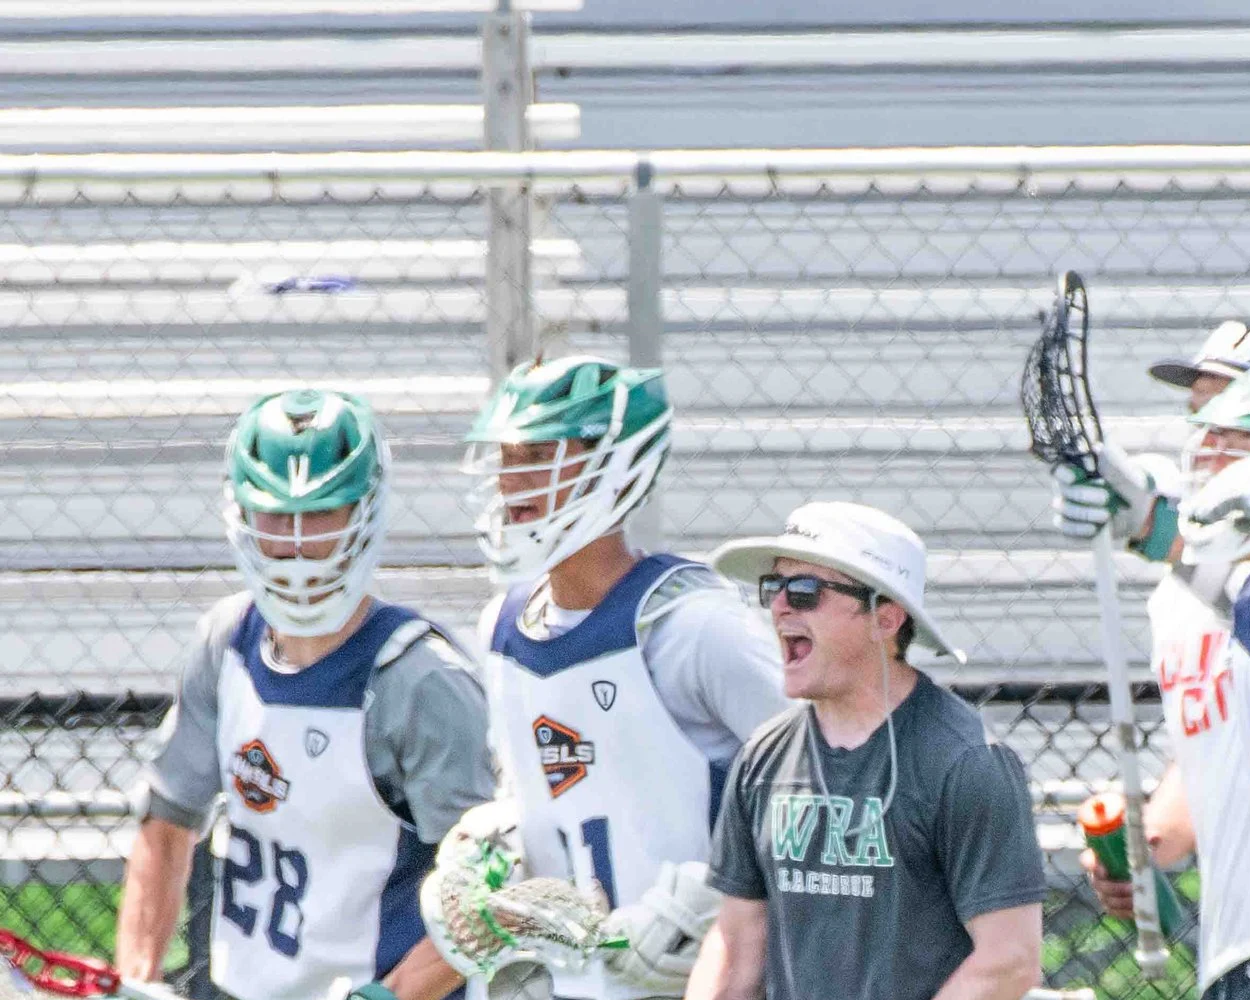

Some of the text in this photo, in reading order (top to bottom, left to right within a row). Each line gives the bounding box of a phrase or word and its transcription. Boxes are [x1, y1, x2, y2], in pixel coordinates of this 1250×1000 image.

[541, 742, 596, 764] SLS
[771, 794, 894, 867] WRA
[222, 823, 309, 958] 28
